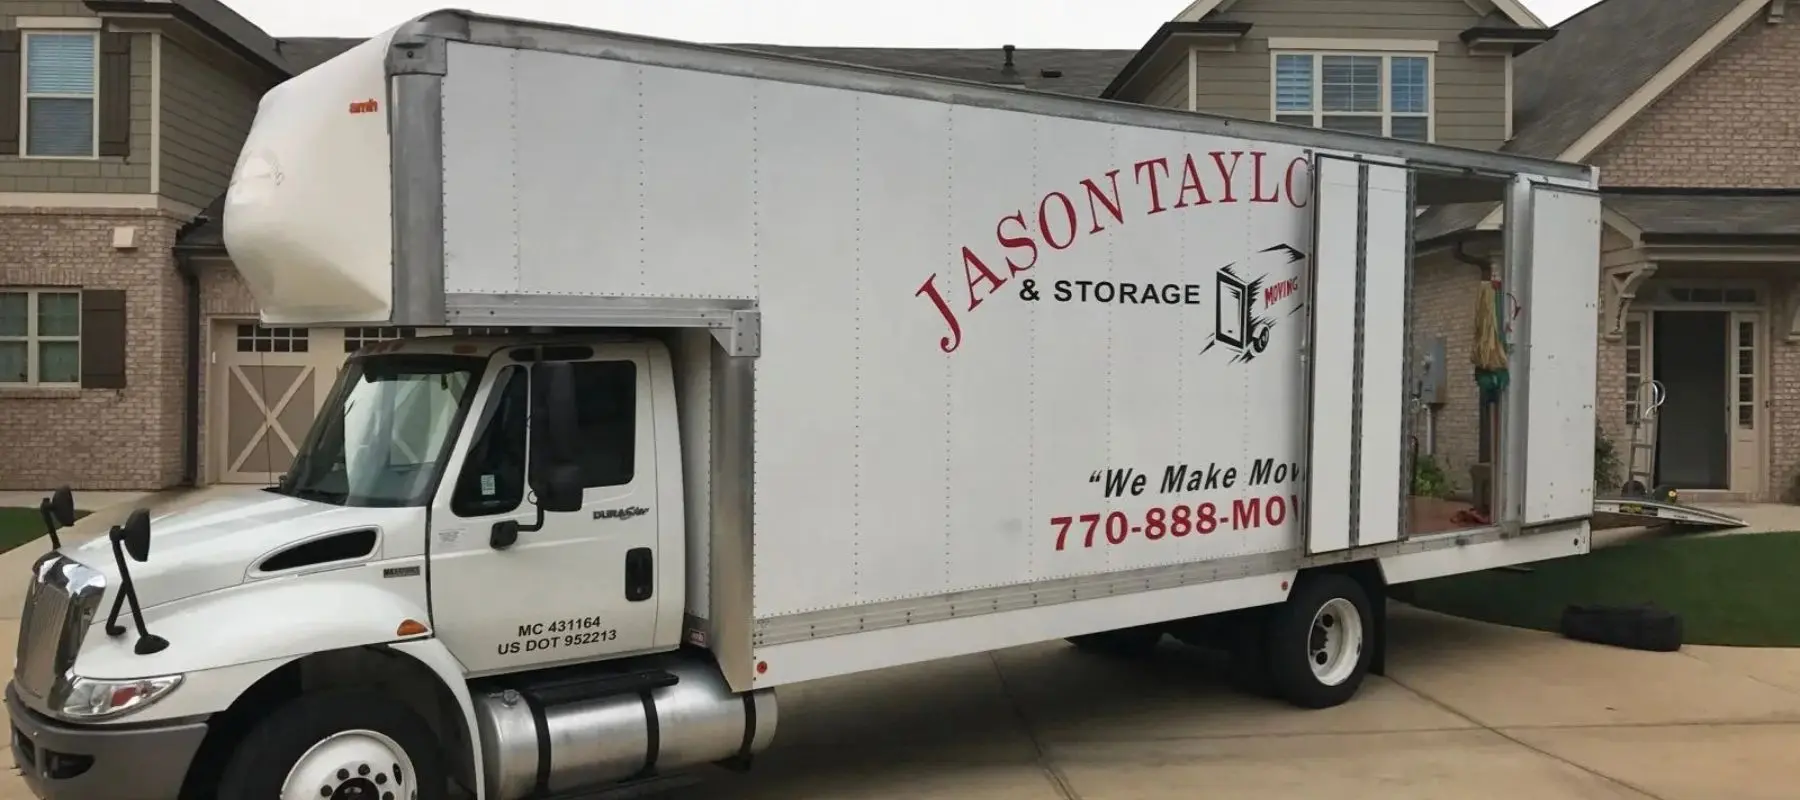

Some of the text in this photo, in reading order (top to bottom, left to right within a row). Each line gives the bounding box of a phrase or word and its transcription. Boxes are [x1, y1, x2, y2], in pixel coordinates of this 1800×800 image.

[914, 169, 1124, 353] JASON
[1019, 278, 1201, 305] & STORAGE
[1264, 275, 1298, 310] MOVING
[1160, 462, 1237, 494] Make
[518, 615, 601, 637] MC 431164
[497, 629, 617, 655] US DOT 952213
